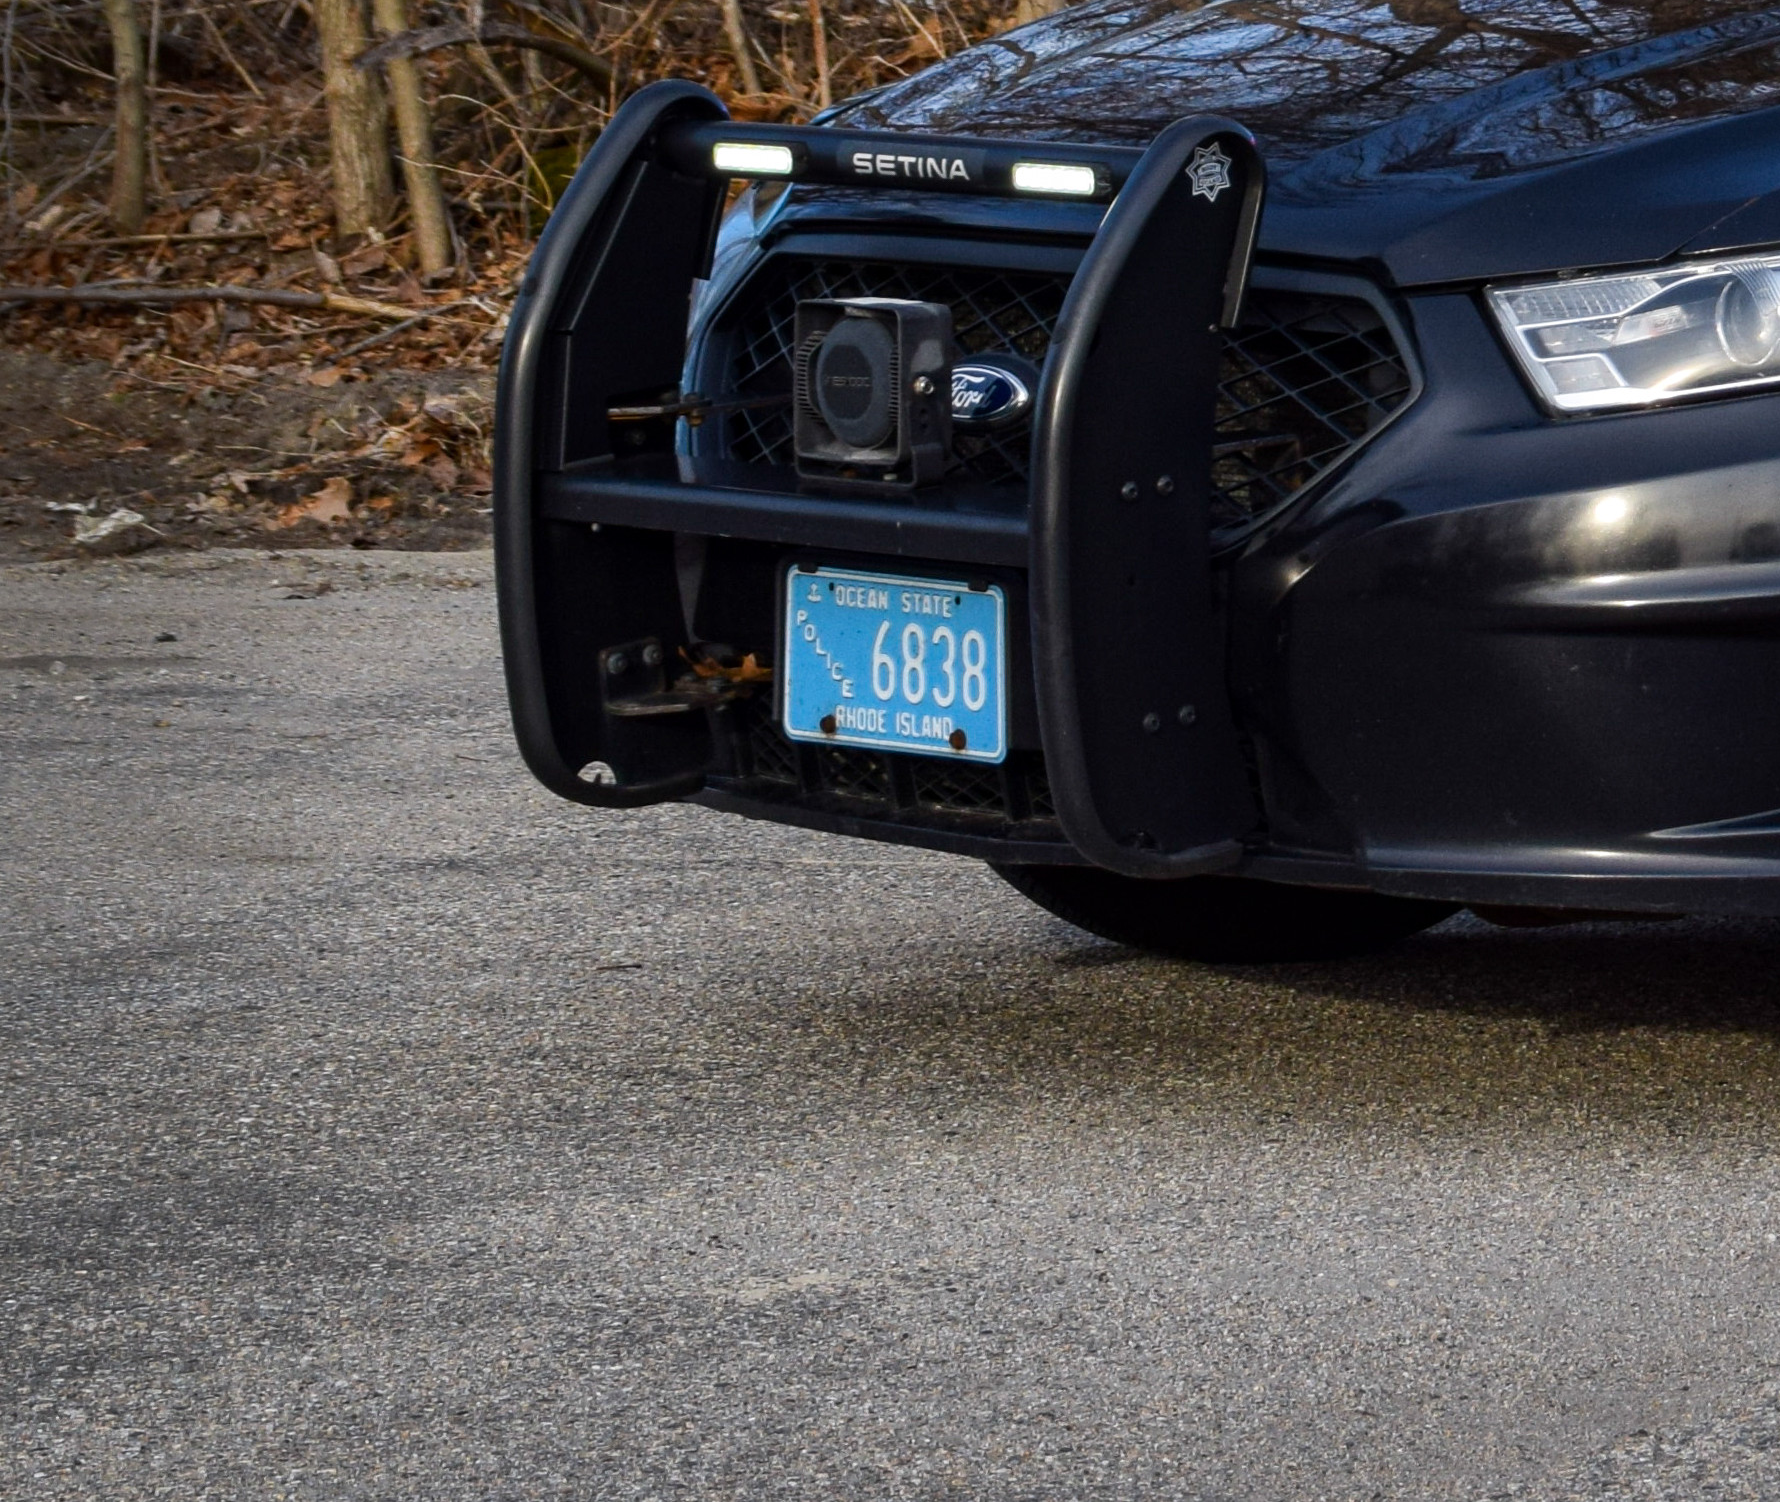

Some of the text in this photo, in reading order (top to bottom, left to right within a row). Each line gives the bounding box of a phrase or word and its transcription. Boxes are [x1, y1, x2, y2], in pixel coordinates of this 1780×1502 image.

[852, 152, 970, 181] SETINA
[835, 585, 952, 618] OCEAN STATE
[797, 609, 853, 698] POLICE
[872, 620, 986, 712] 6838
[835, 705, 953, 741] RHODE ISLAND
